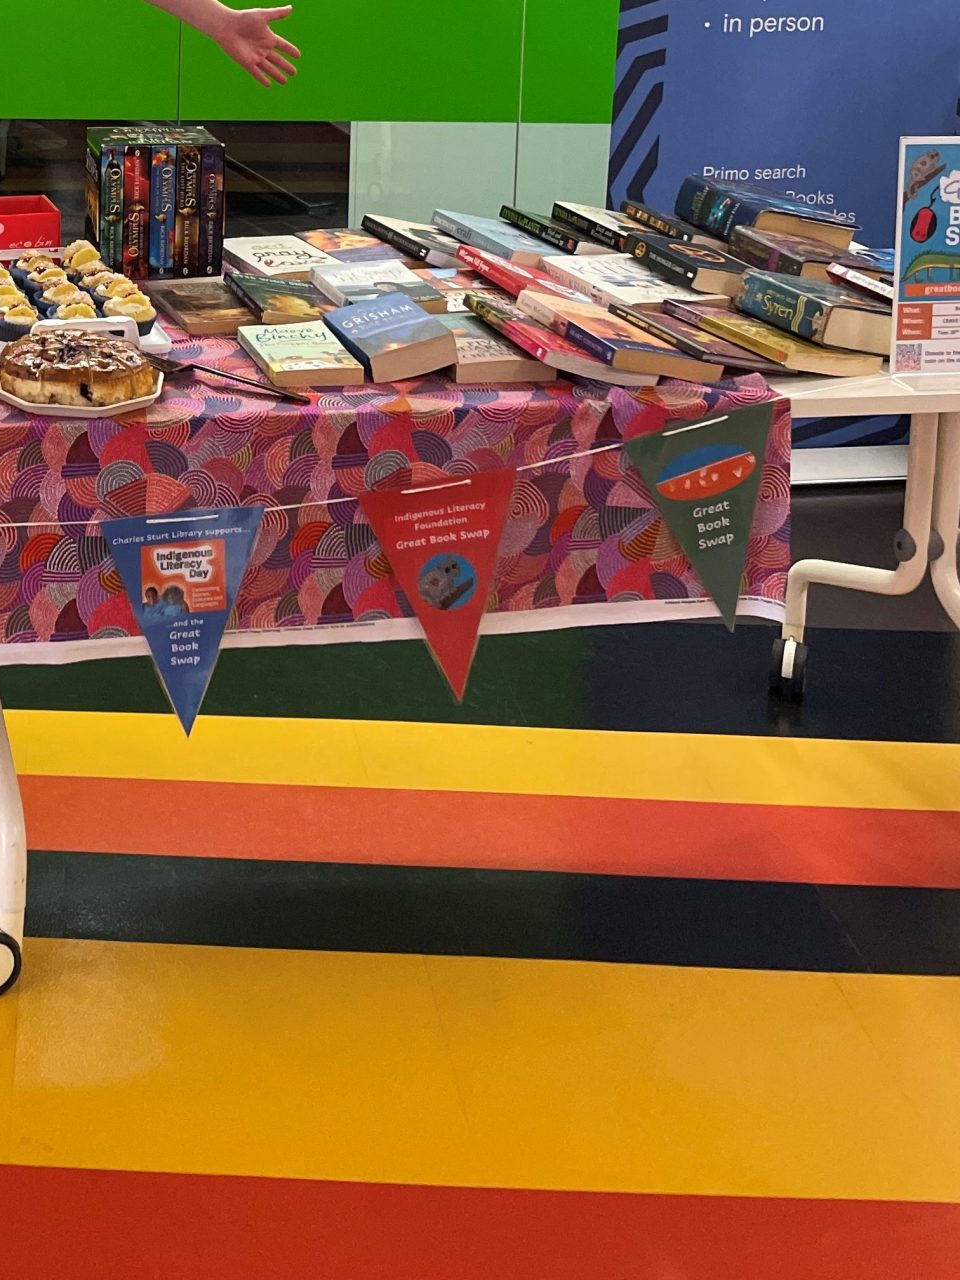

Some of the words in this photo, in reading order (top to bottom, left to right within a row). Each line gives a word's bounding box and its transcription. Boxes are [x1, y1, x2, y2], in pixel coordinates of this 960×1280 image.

[723, 14, 741, 32] in
[749, 16, 825, 37] person
[702, 166, 750, 180] Primo
[755, 165, 806, 180] search
[456, 226, 472, 240] craft
[762, 295, 794, 320] Syren
[342, 304, 414, 328] GRISHAM
[256, 331, 327, 342] Binchy
[394, 508, 445, 523] Indigenous
[447, 501, 486, 514] Literacy
[692, 500, 730, 518] Great
[414, 516, 468, 531] Foundation
[697, 517, 730, 534] Book
[112, 535, 145, 546] Charles
[147, 531, 170, 542] Sturt
[172, 528, 203, 541] Library
[396, 537, 427, 550] Great
[429, 532, 457, 545] Book
[460, 528, 490, 540] Swap
[698, 532, 735, 550] Swap
[156, 548, 213, 563] Indigenous
[160, 559, 203, 571] Literacy
[189, 569, 210, 579] Day
[190, 618, 204, 626] the
[169, 629, 201, 640] Great
[171, 642, 199, 653] Book
[170, 655, 201, 666] Swap
